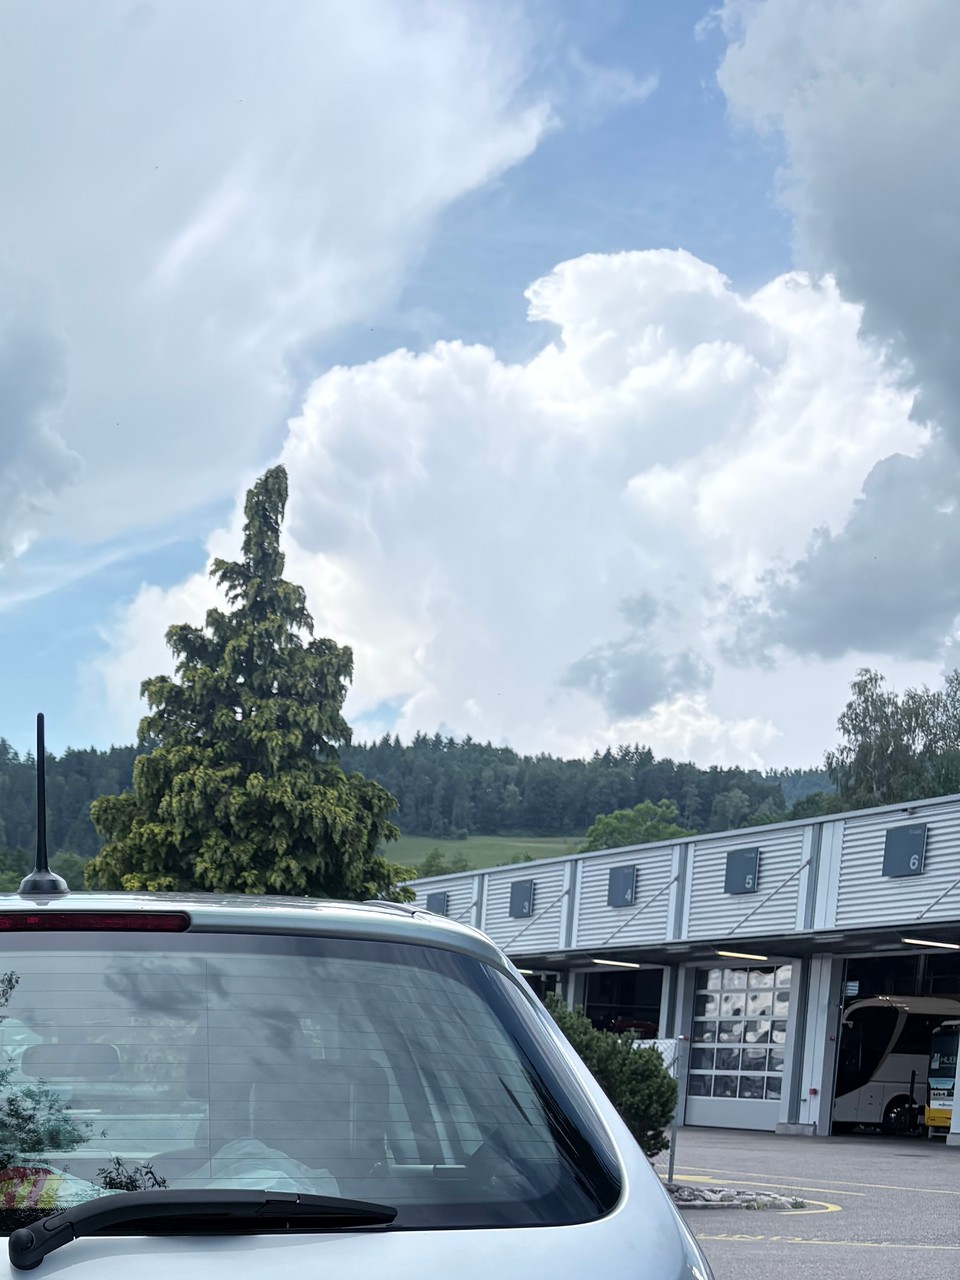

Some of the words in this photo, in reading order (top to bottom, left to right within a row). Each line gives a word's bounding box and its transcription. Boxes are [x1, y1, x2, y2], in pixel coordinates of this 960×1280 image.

[910, 854, 919, 870] 6
[745, 874, 753, 889] 5
[624, 888, 632, 902] 4
[522, 901, 529, 914] 3
